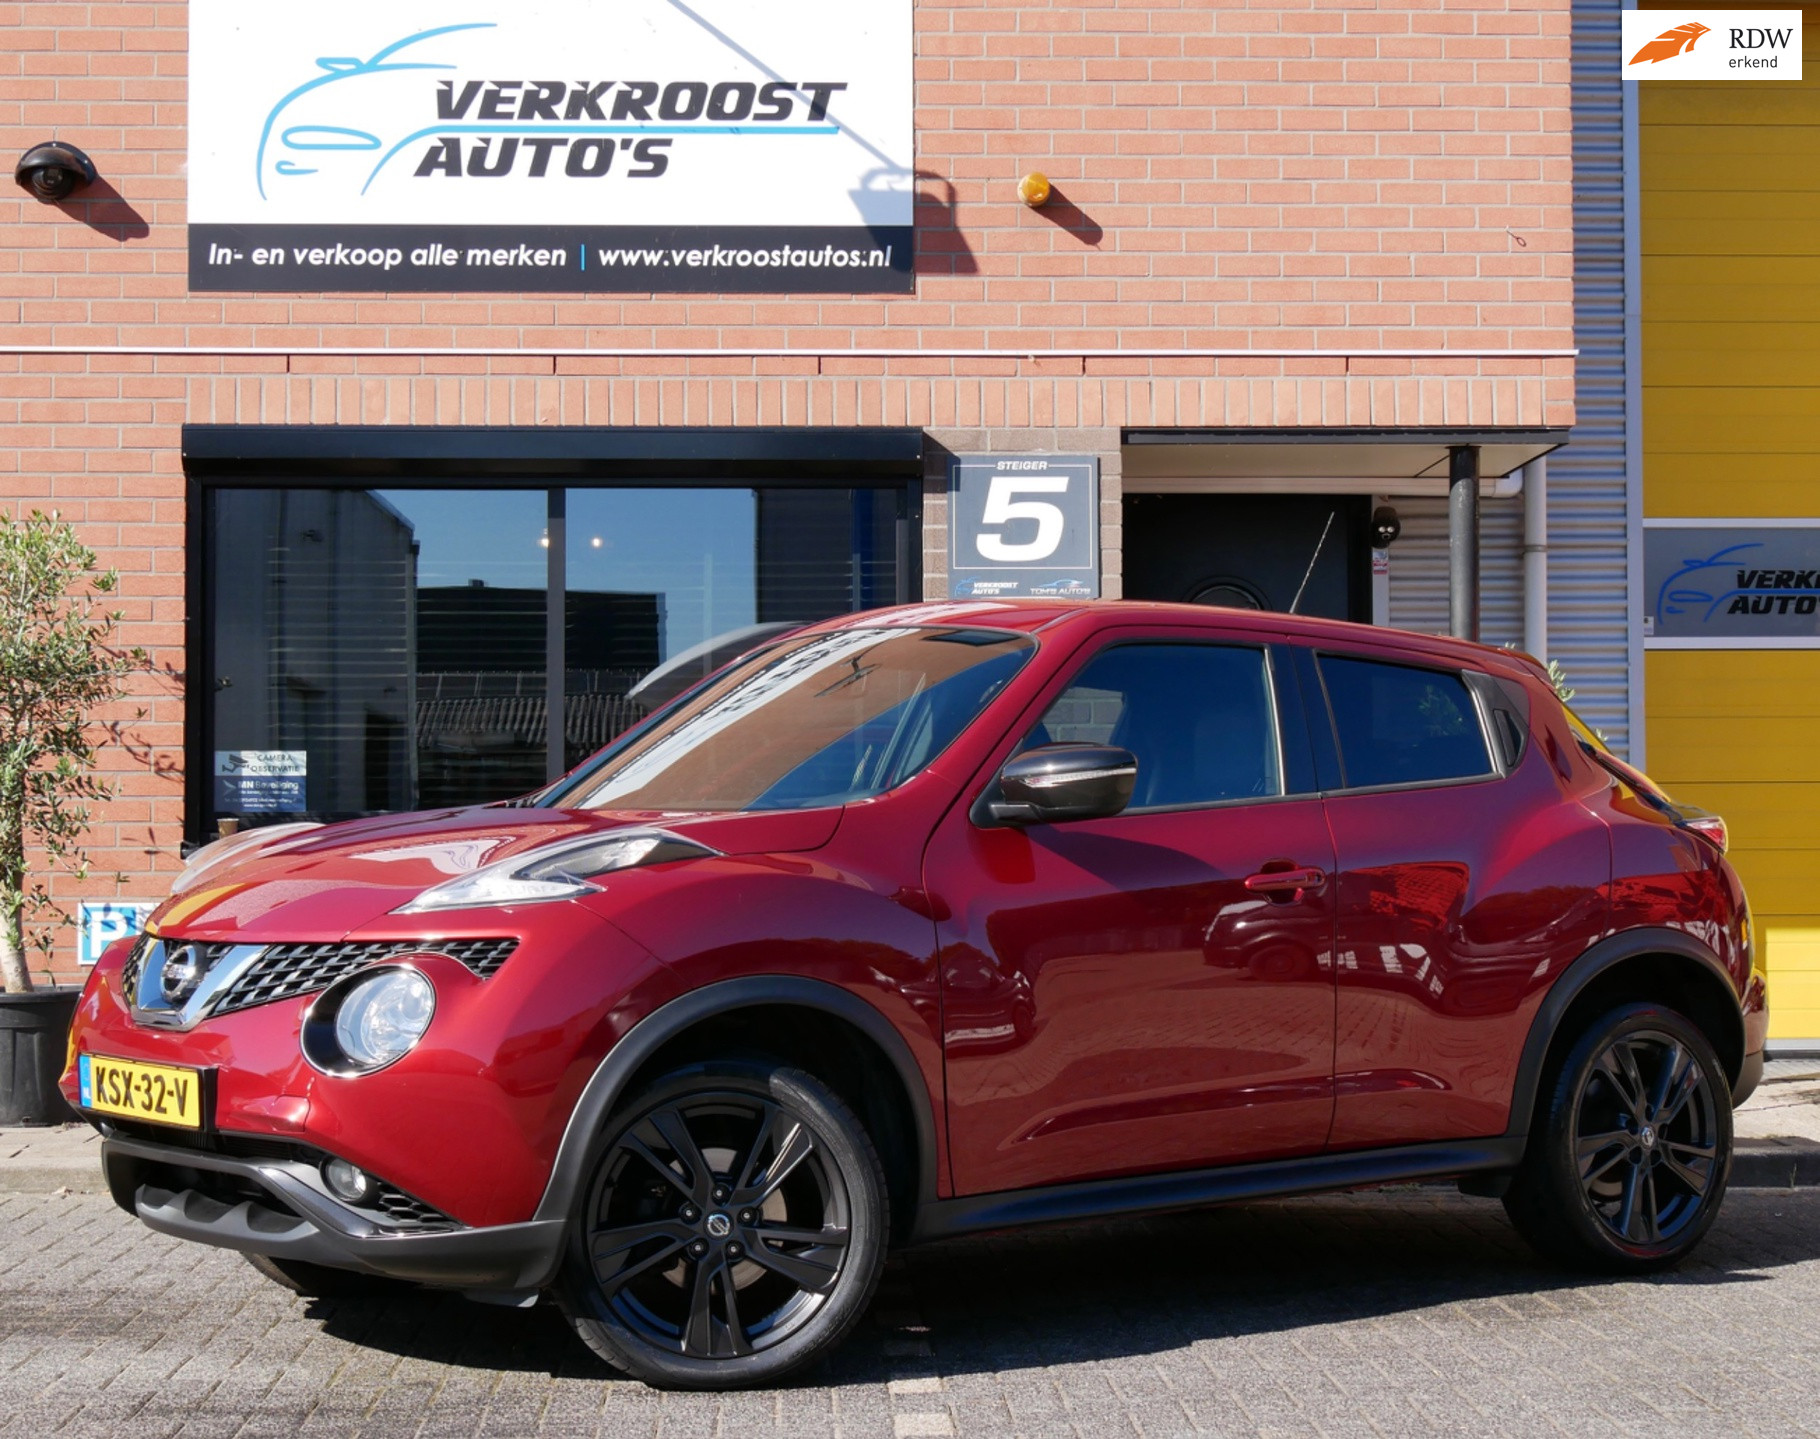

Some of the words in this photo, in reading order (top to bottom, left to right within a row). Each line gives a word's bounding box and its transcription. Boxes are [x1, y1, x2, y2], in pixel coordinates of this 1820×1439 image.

[435, 80, 848, 121] VERKROOST
[413, 137, 673, 178] AUTO'S
[208, 243, 243, 265] In-
[251, 248, 284, 265] en
[293, 244, 402, 270] verkoop
[410, 244, 458, 266] alle
[466, 244, 567, 266] merken
[599, 245, 892, 268] www.verkroostautos.nl
[996, 461, 1048, 471] STEIGER
[976, 476, 1070, 562] 5
[1737, 570, 1820, 589] VERK
[257, 754, 293, 762] CAMERA
[91, 911, 128, 959] P
[95, 1064, 189, 1118] KSX-32-V
